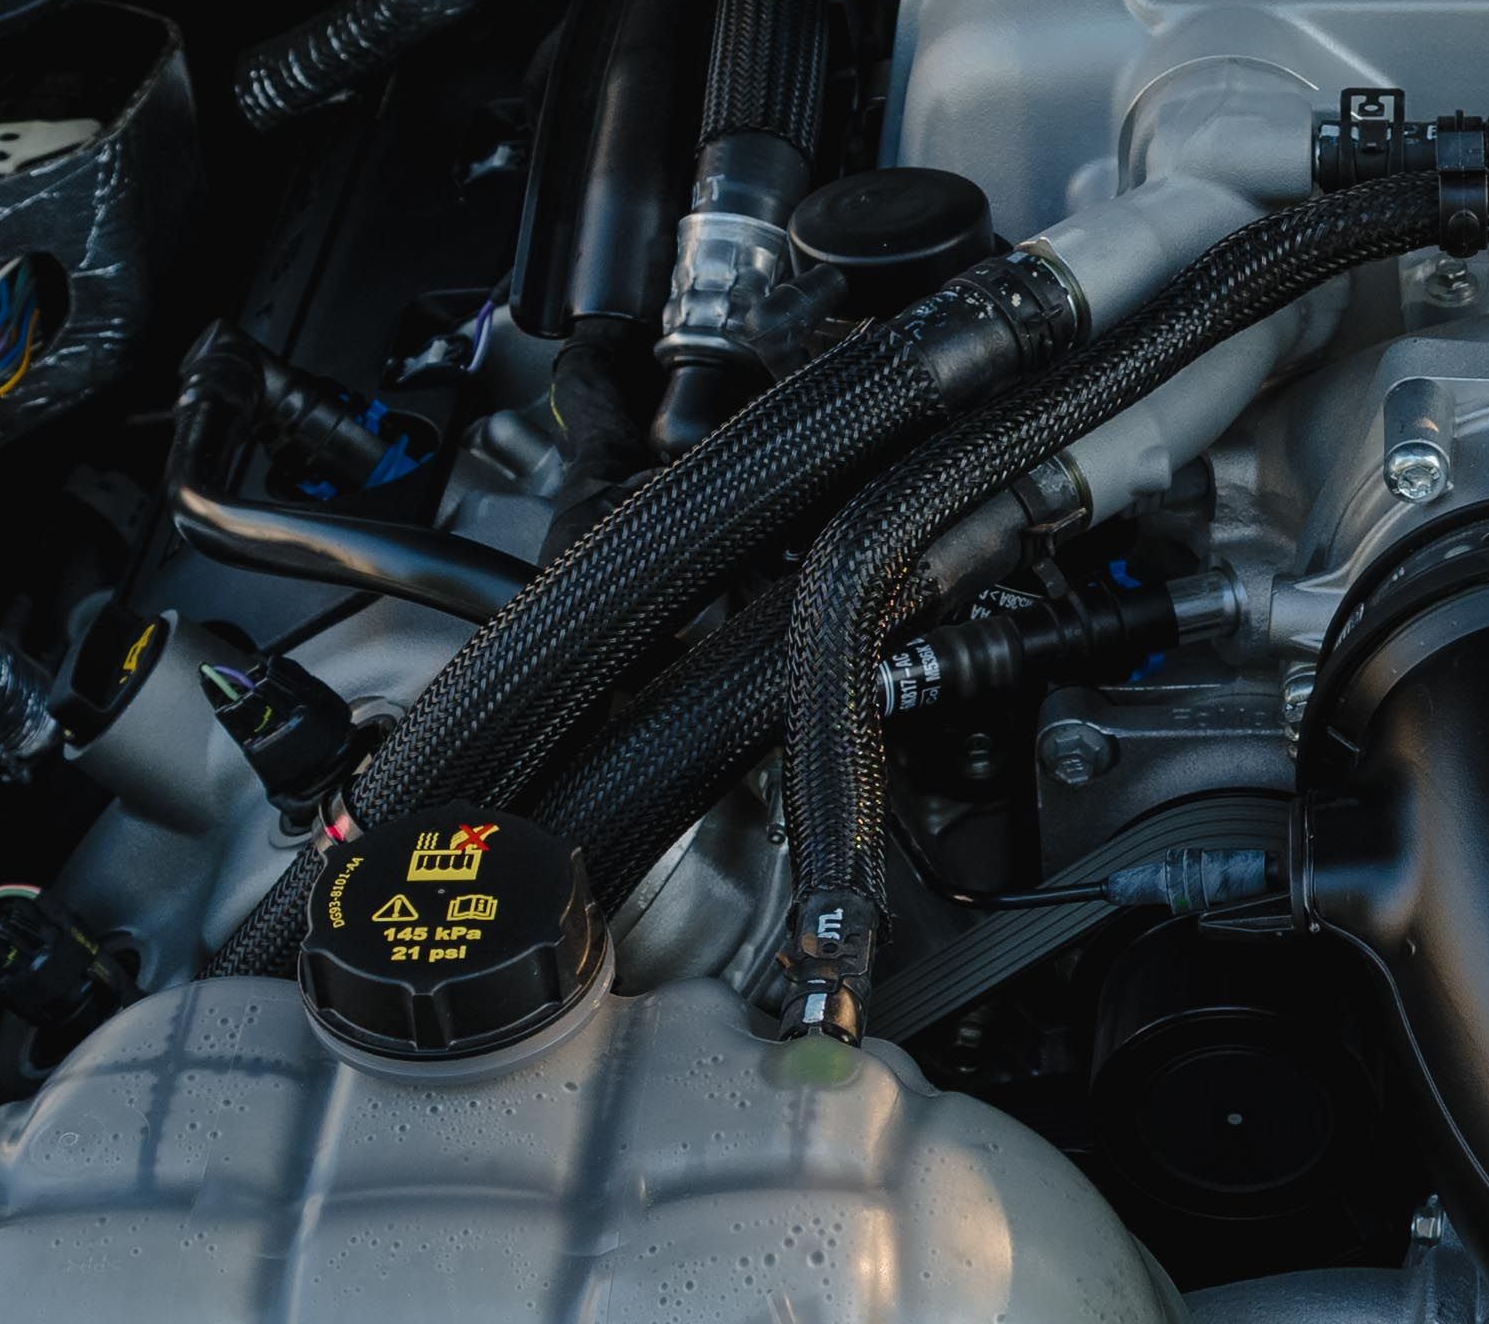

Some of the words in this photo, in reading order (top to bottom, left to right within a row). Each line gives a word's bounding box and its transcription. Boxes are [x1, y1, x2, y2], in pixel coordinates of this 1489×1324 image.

[382, 927, 428, 942] 145
[434, 926, 483, 942] kPa
[389, 945, 420, 962] 21
[428, 945, 468, 963] psi
